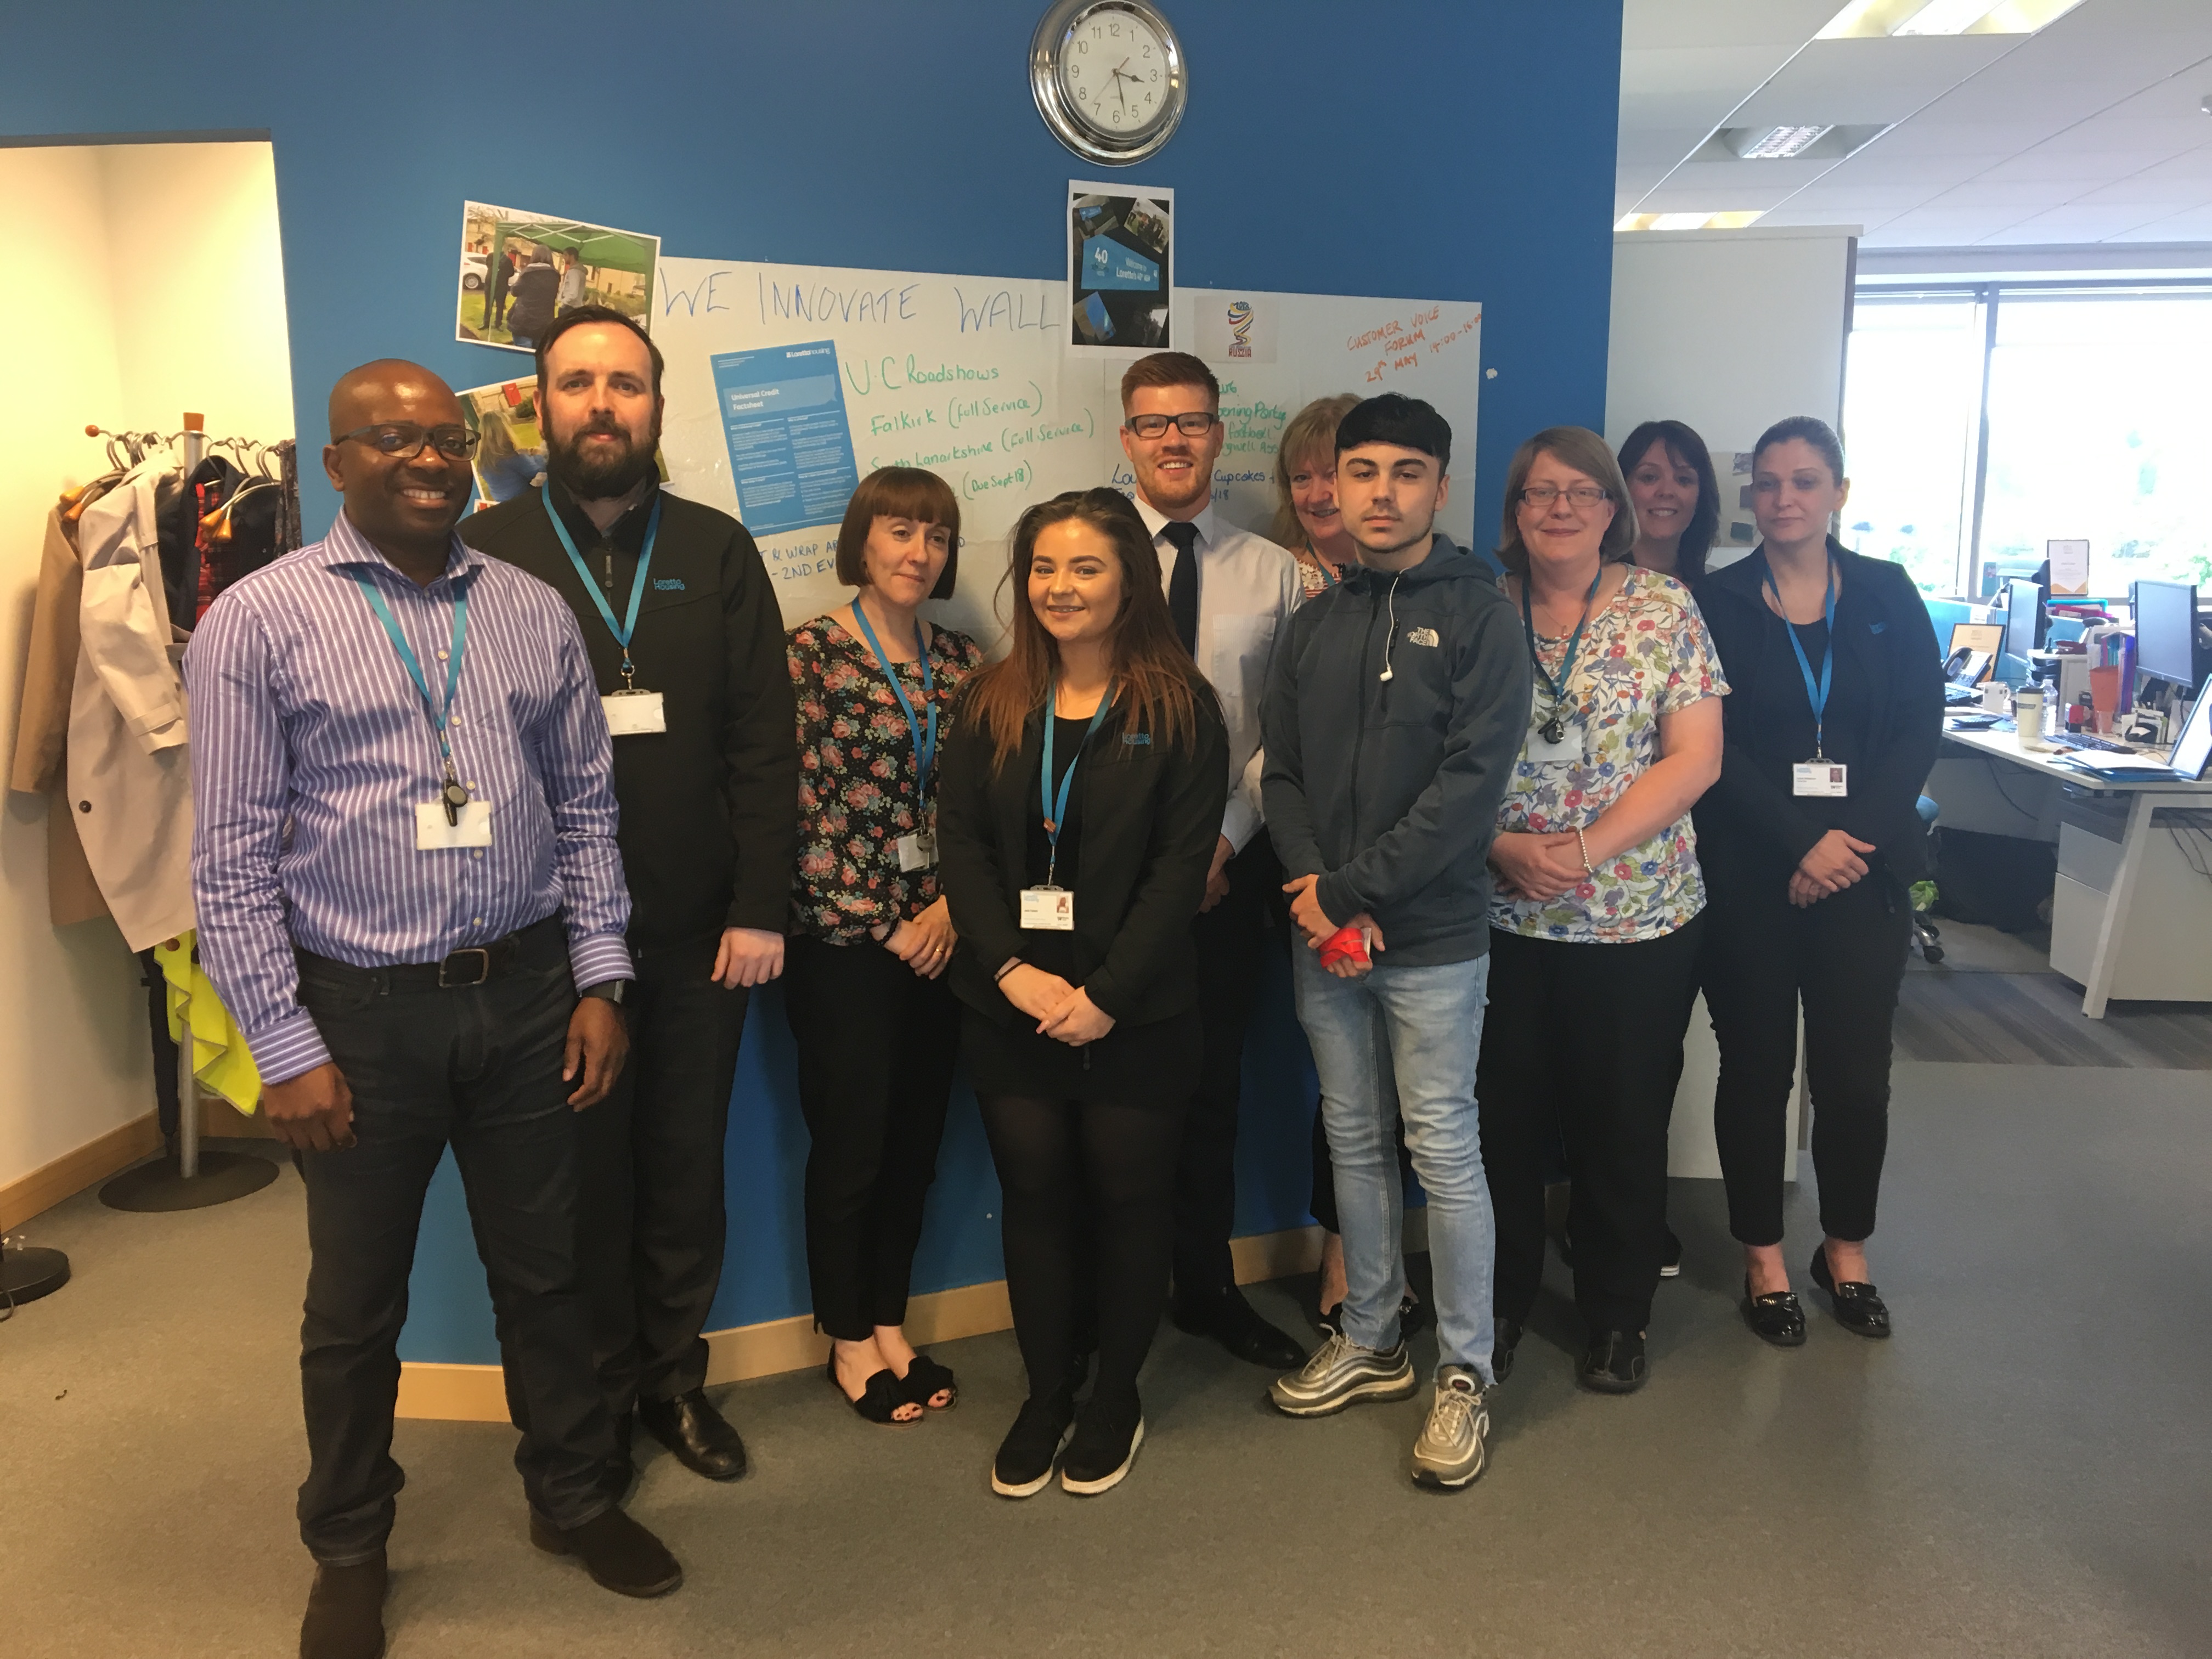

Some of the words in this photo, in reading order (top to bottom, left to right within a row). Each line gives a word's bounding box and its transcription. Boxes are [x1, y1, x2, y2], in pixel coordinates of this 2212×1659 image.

[1092, 26, 1102, 39] 11
[1108, 23, 1120, 37] 12
[1130, 30, 1134, 42] 1
[1077, 41, 1088, 54] 10
[1142, 45, 1150, 58] 2
[1071, 65, 1079, 78] 9
[1150, 69, 1157, 82] 3
[1079, 87, 1086, 100] 8
[1144, 91, 1152, 104] 4
[1093, 103, 1101, 116] 7
[1131, 105, 1138, 118] 5
[1113, 110, 1120, 123] 6
[1094, 247, 1108, 263] 40
[659, 268, 732, 317] WE
[759, 272, 920, 325] INNOVATE
[953, 286, 1060, 333] WALL
[1347, 320, 1403, 351] CUSTOMER
[1410, 305, 1439, 328] VOICE
[1384, 328, 1426, 356] FORUM
[1395, 352, 1418, 371] MAY
[906, 354, 999, 383] Roadshows
[731, 391, 760, 400] Universal
[761, 388, 780, 397] Credit
[733, 401, 764, 410] Factsheet
[1214, 469, 1265, 486] Cupcakes
[786, 543, 819, 559] WRAP
[816, 558, 834, 573] EV
[1417, 627, 1430, 635] THE
[1409, 636, 1427, 646] FACE
